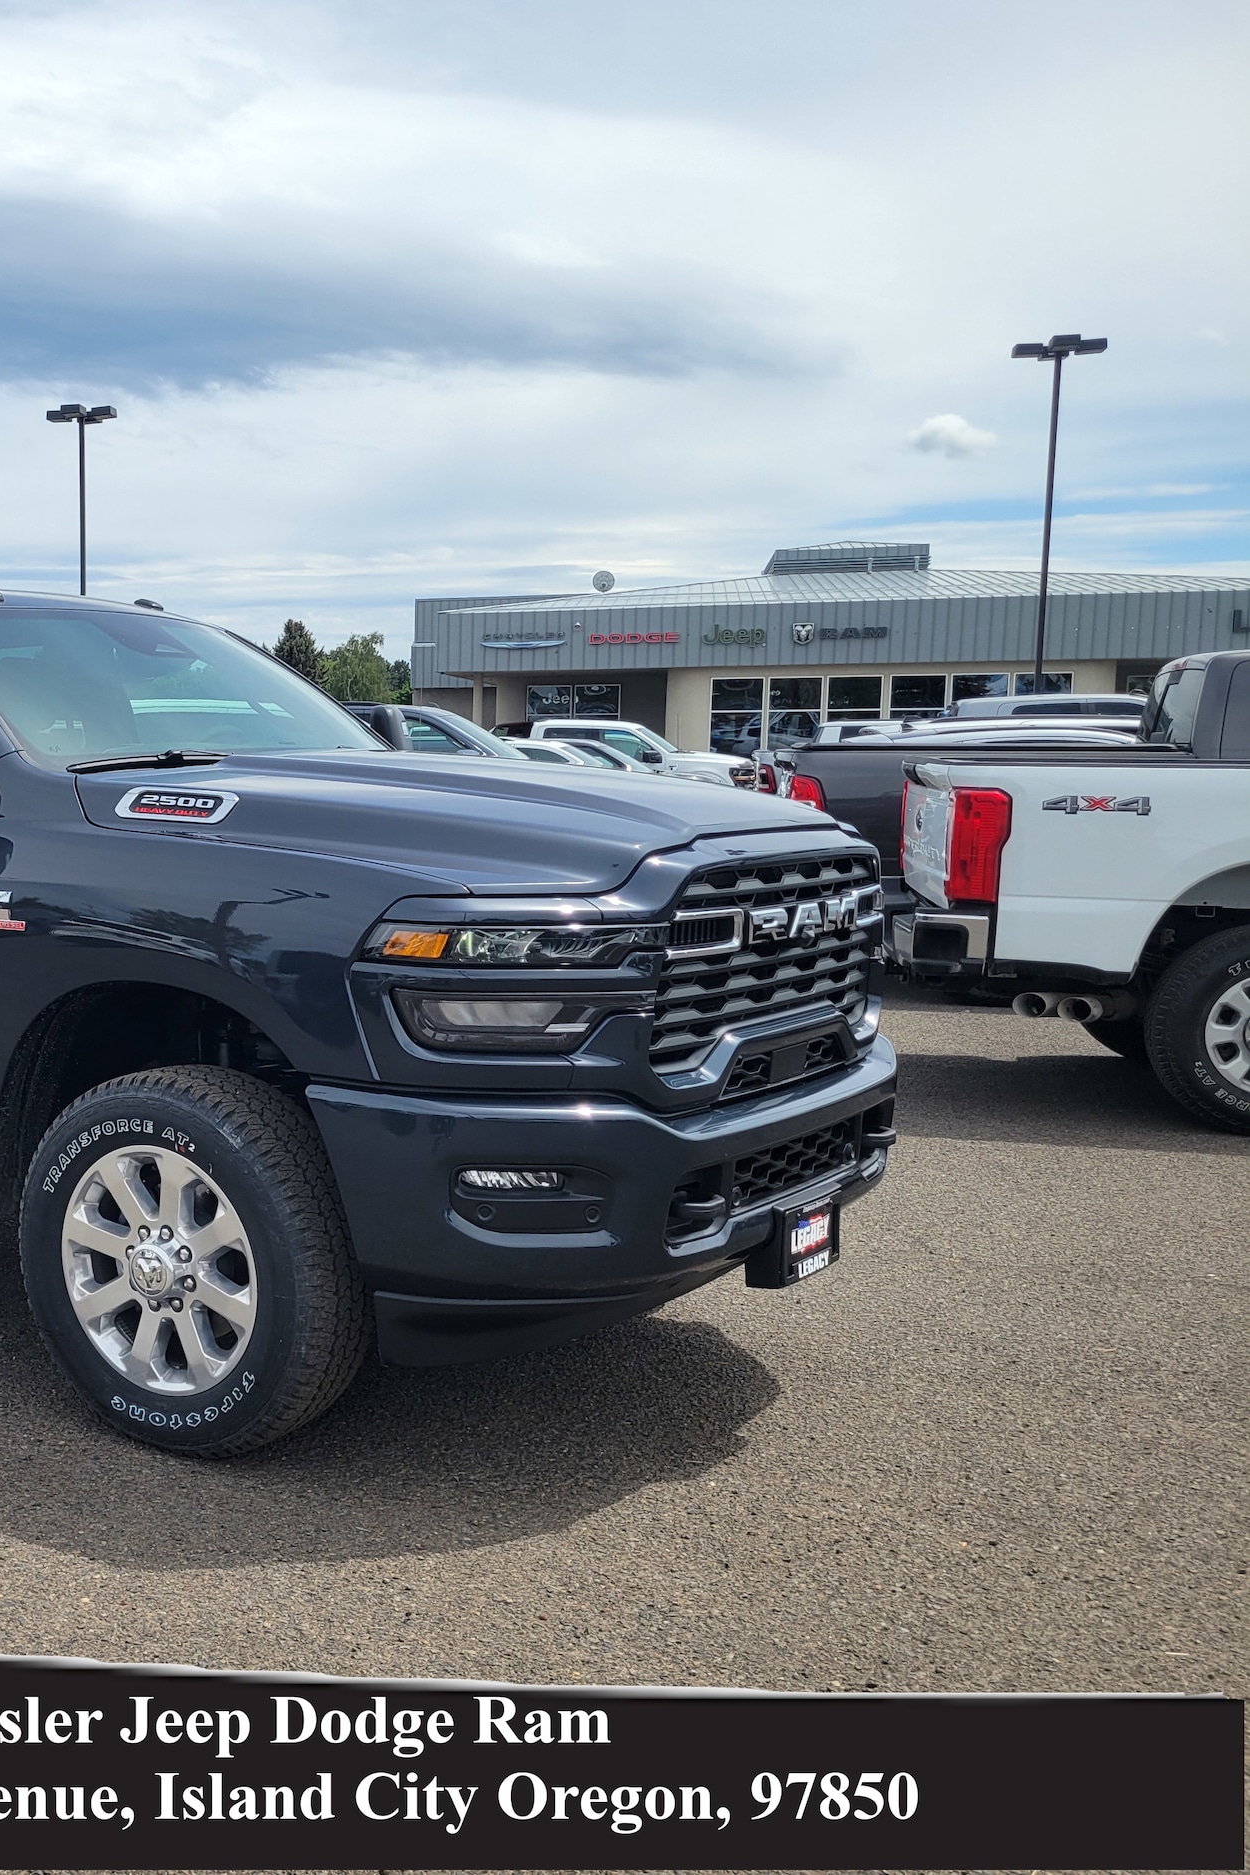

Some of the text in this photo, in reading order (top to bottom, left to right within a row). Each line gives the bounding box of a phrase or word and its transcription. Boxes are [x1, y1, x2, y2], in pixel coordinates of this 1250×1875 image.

[588, 631, 680, 645] DODGE
[702, 624, 767, 648] Jeep
[819, 626, 888, 640] RAM
[134, 806, 209, 817] HEAVY DUTY
[141, 795, 215, 808] 2500
[749, 895, 857, 945] RAM
[42, 1118, 154, 1194] TRANSFORCE
[791, 1213, 830, 1253] LEGACY
[798, 1251, 829, 1279] LEGACY
[110, 1371, 256, 1430] Firestone
